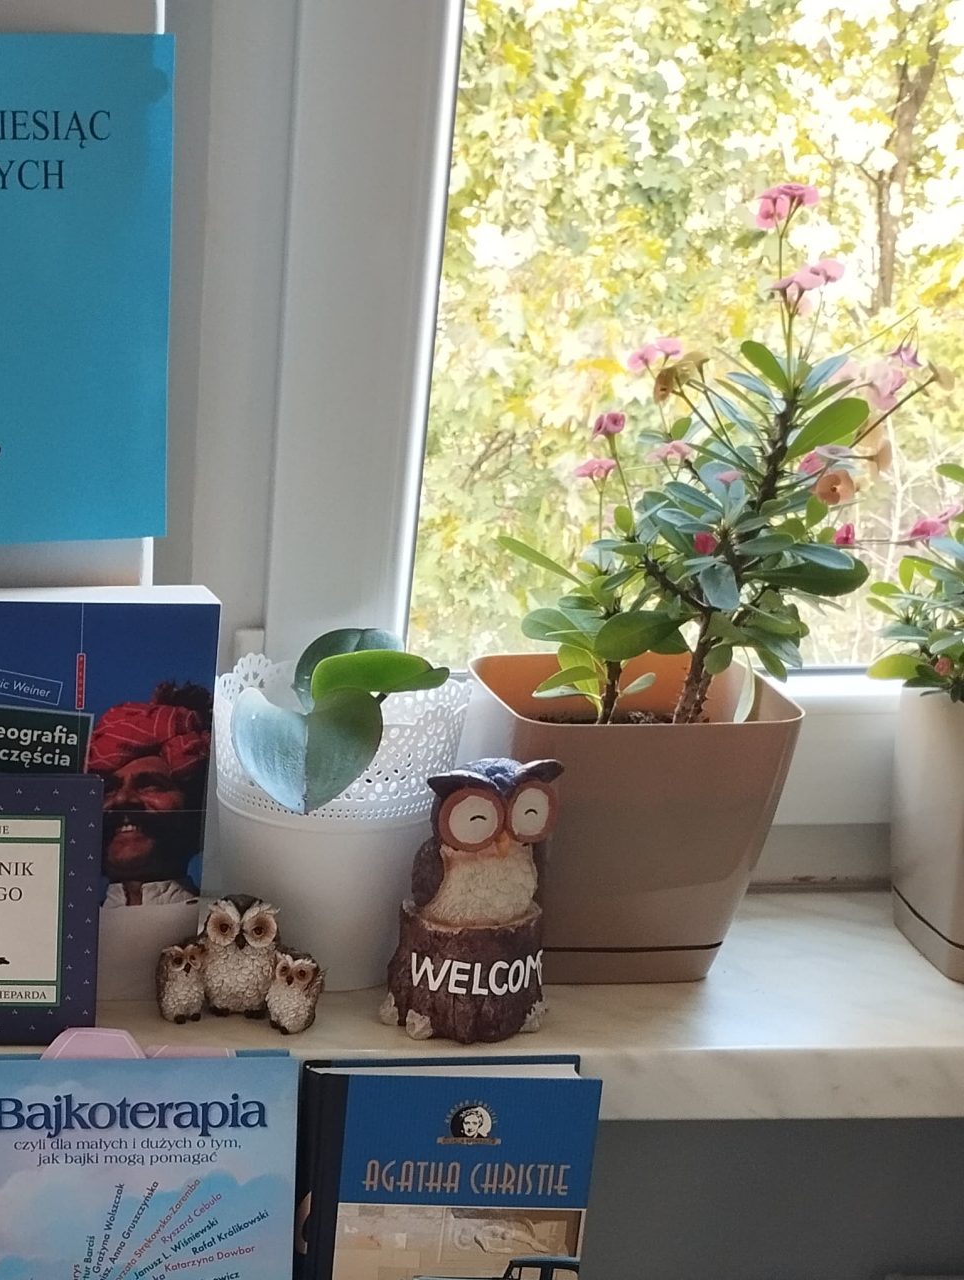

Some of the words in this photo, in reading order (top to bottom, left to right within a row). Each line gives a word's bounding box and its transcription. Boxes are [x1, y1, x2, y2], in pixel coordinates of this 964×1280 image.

[14, 680, 50, 698] Weiner
[14, 1138, 46, 1151] czyli
[51, 1139, 72, 1150] dla
[77, 1138, 127, 1152] małych
[141, 1137, 192, 1151] dużych
[211, 1138, 241, 1150] tym,
[38, 1153, 60, 1166] jak
[65, 1153, 99, 1166] bajki
[104, 1155, 145, 1166] mogą
[150, 1152, 217, 1166] pomagać
[362, 1160, 461, 1193] AGATHA
[471, 1163, 571, 1195] CHRISTIE
[106, 1183, 125, 1230] Wolszczak
[160, 1216, 193, 1244] Ryszard
[171, 1218, 219, 1253] Wiśniewski
[217, 1210, 269, 1241] Królikowski
[165, 1254, 214, 1272] Katarzyna
[216, 1245, 255, 1260] Dowbor
